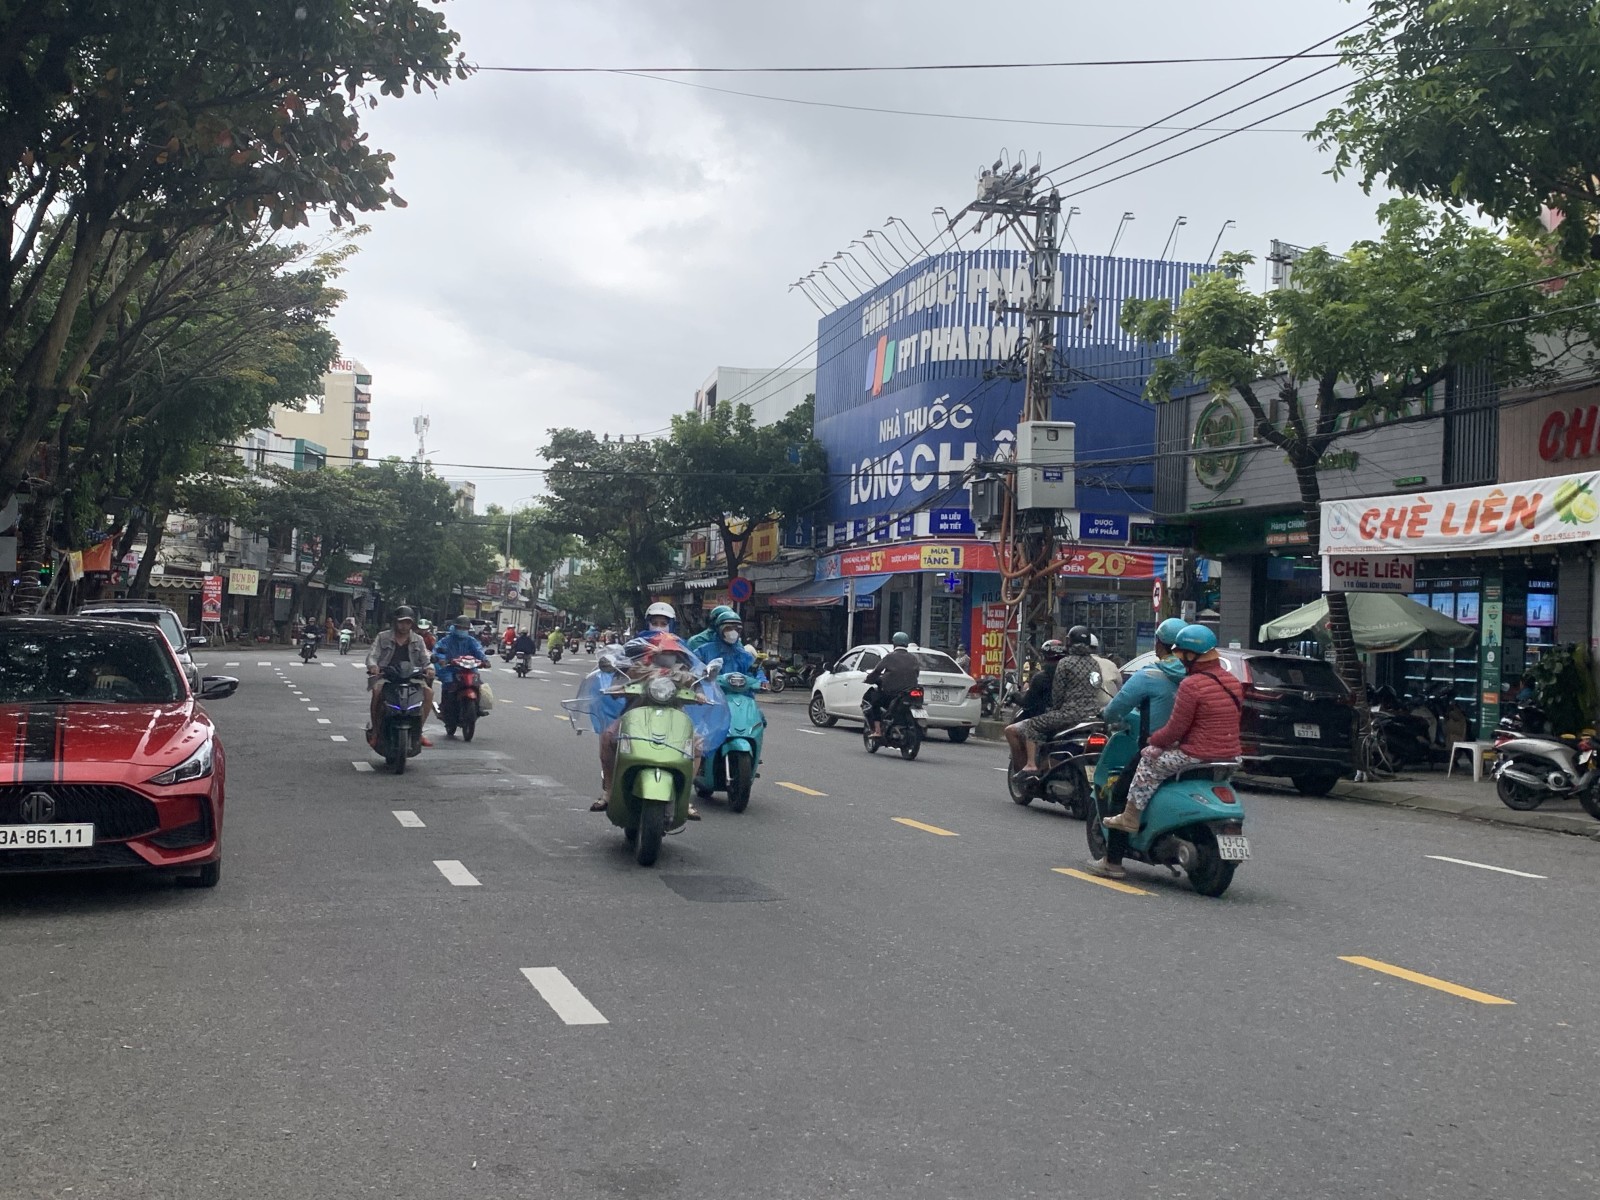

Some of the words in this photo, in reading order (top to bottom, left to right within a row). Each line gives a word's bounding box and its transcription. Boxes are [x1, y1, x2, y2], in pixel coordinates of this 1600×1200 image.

[893, 284, 906, 324] TY
[908, 266, 957, 316] DƯỢC
[898, 333, 919, 373] FPT
[879, 408, 900, 443] NHÀ
[904, 394, 973, 435] THUỐC
[1539, 405, 1600, 462] CH
[850, 450, 904, 505] LONG
[1359, 496, 1433, 540] CHÈ
[1440, 489, 1543, 536] LIÊN
[924, 556, 950, 567] TẶNG
[951, 547, 961, 566] 1
[1333, 557, 1369, 578] CHÈ
[985, 649, 1003, 662] UẤT
[0, 828, 82, 845] 3A-861.11
